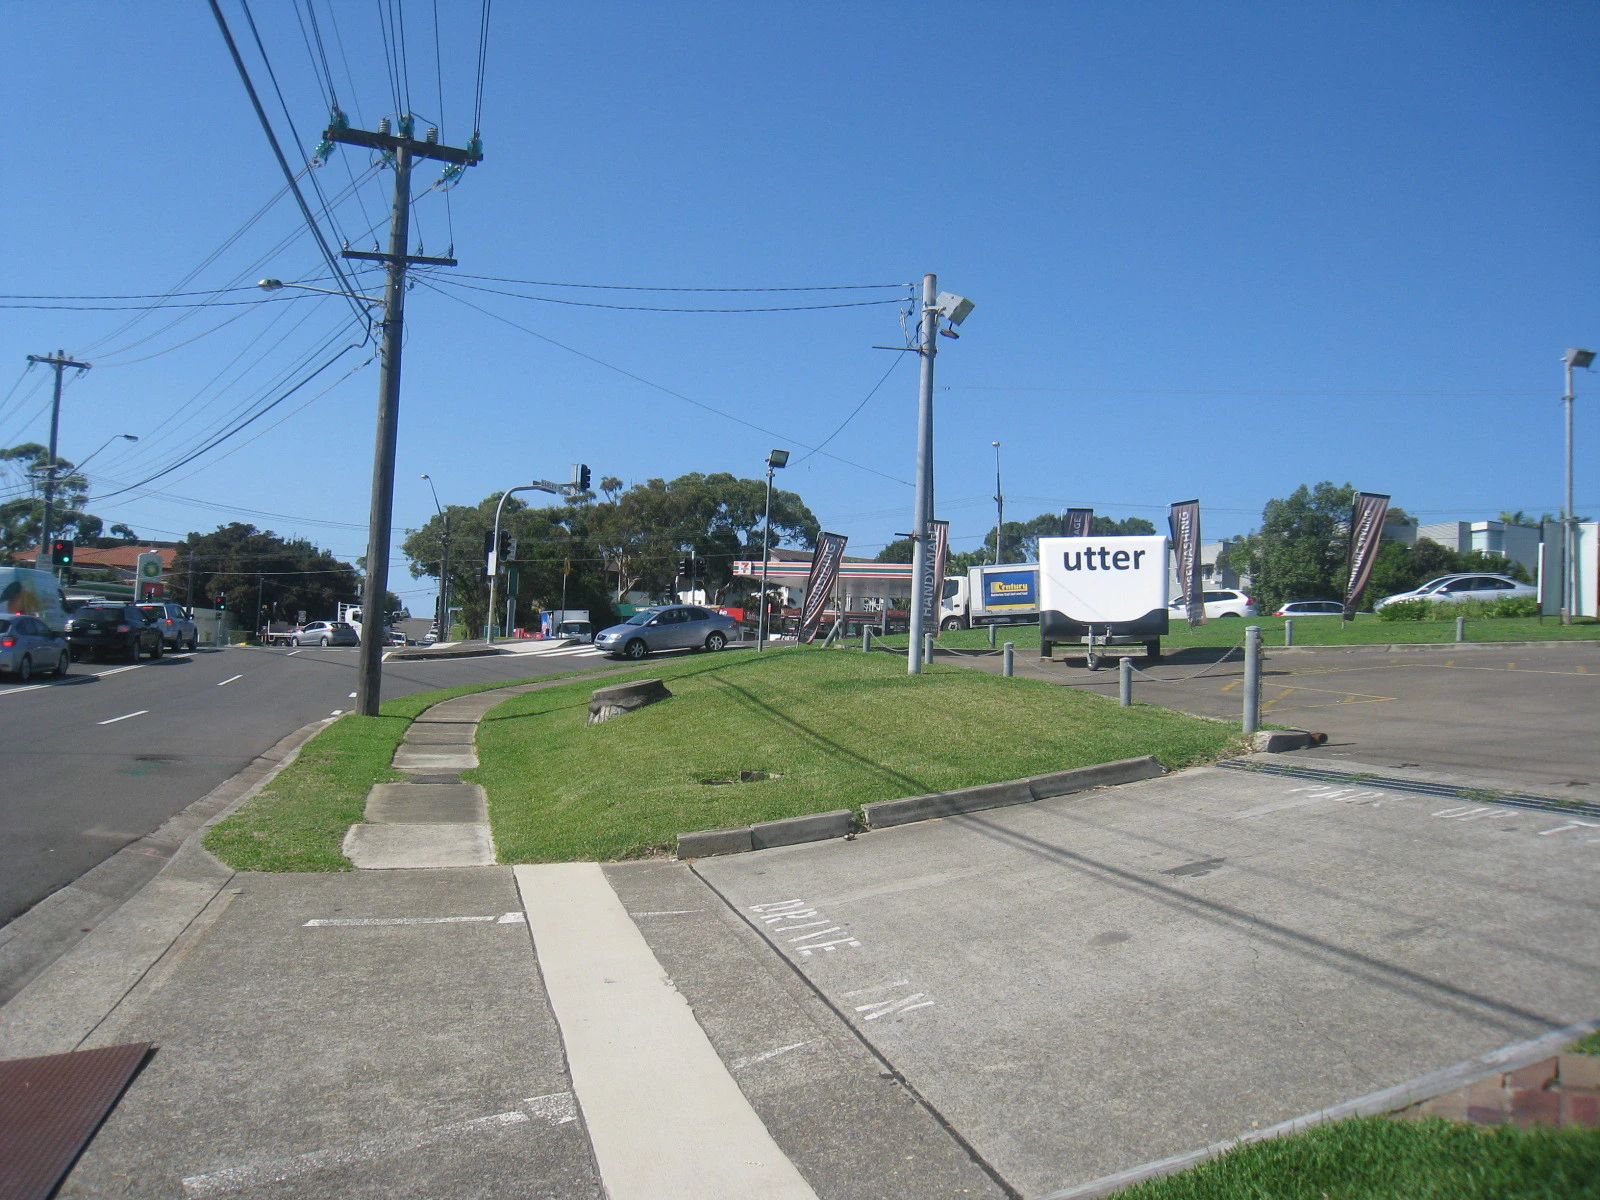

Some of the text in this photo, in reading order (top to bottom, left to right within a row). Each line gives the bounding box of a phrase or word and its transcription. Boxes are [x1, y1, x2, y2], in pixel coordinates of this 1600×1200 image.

[1073, 517, 1081, 537] AGE
[1063, 546, 1146, 571] utter
[992, 581, 1029, 592] Century
[1431, 805, 1519, 821] UP
[1538, 820, 1600, 843] T
[749, 898, 935, 1021] DRIVE IN
